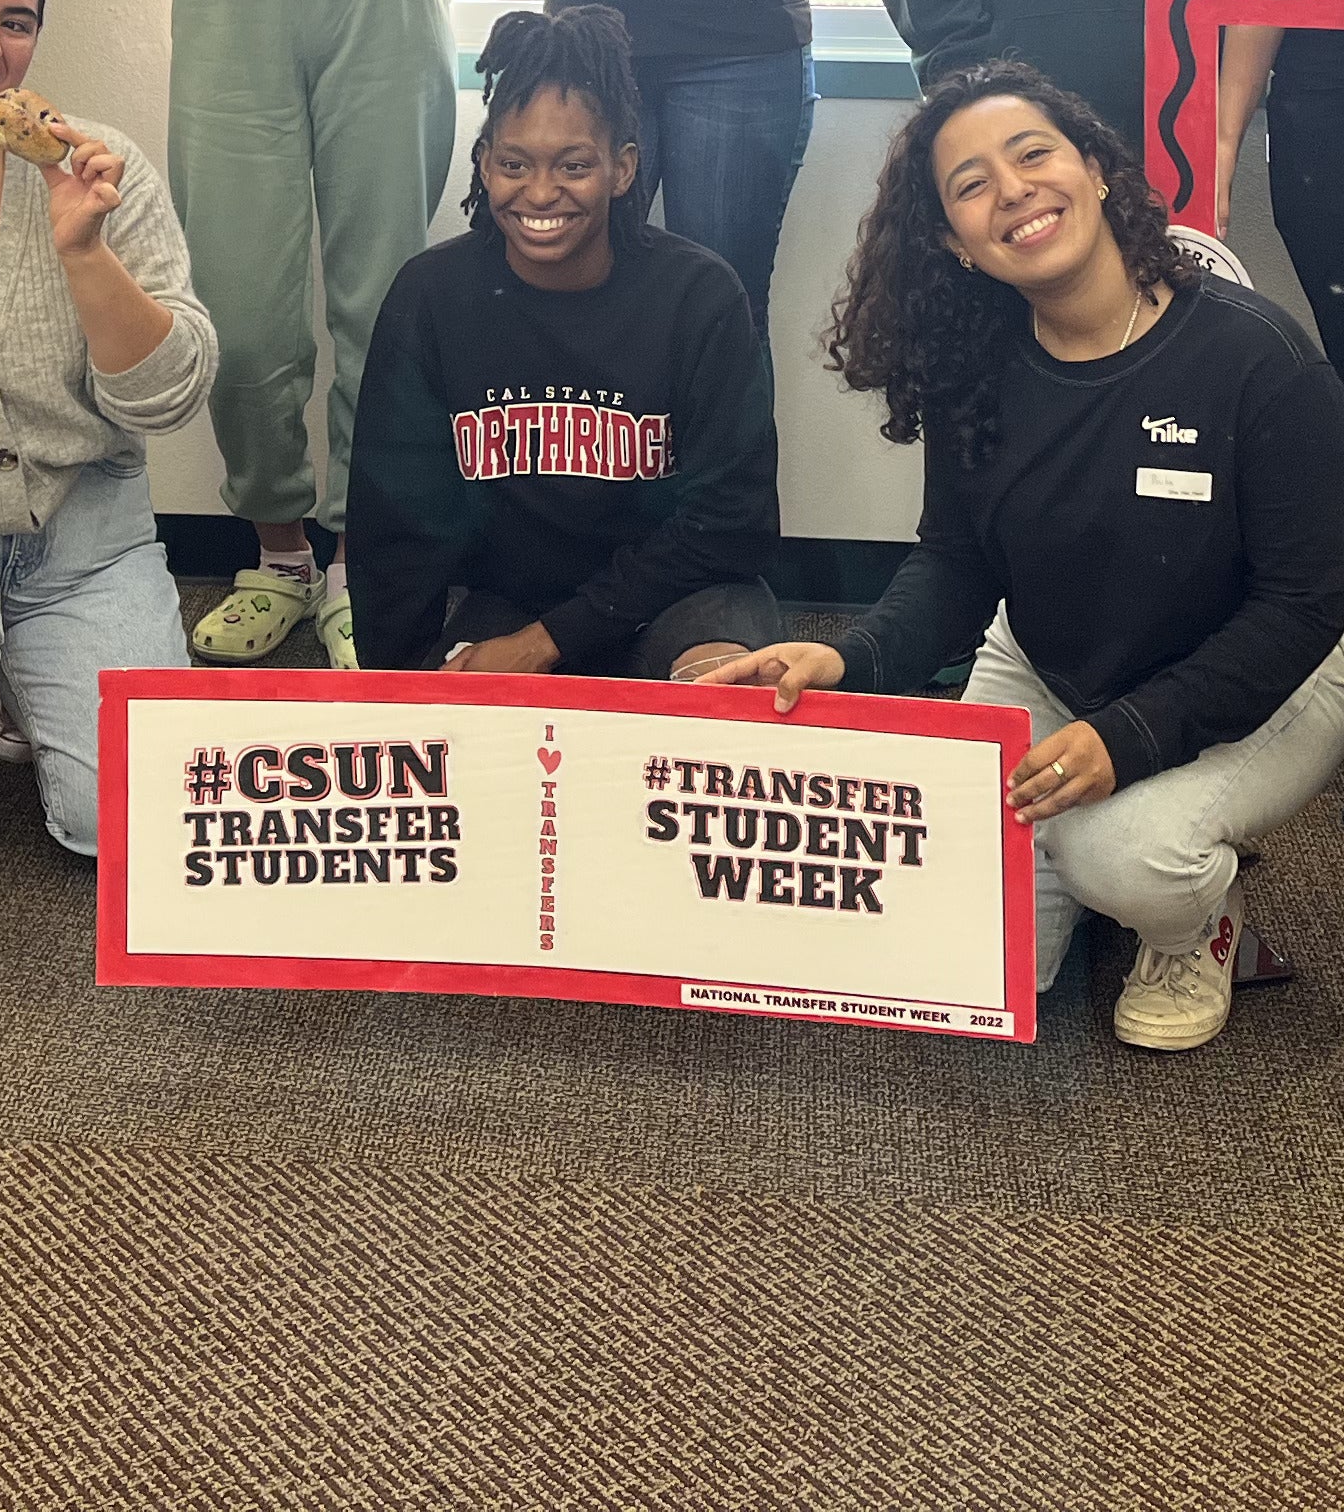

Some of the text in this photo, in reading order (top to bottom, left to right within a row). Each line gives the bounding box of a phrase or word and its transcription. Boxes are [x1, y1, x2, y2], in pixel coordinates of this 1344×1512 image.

[486, 386, 624, 406] CAL STATE
[1150, 423, 1199, 444] nike
[184, 740, 449, 805] #CSUN
[644, 756, 923, 820] #TRANSFER
[183, 805, 461, 848] TRANSFER
[540, 723, 557, 951] I TRANSFERS
[645, 799, 927, 866] STUDENT
[184, 846, 459, 887] STUDENTS
[690, 853, 884, 915] WEEK
[690, 988, 1004, 1028] NATIONAL TRANSFER STUDENT WEEK 2022
